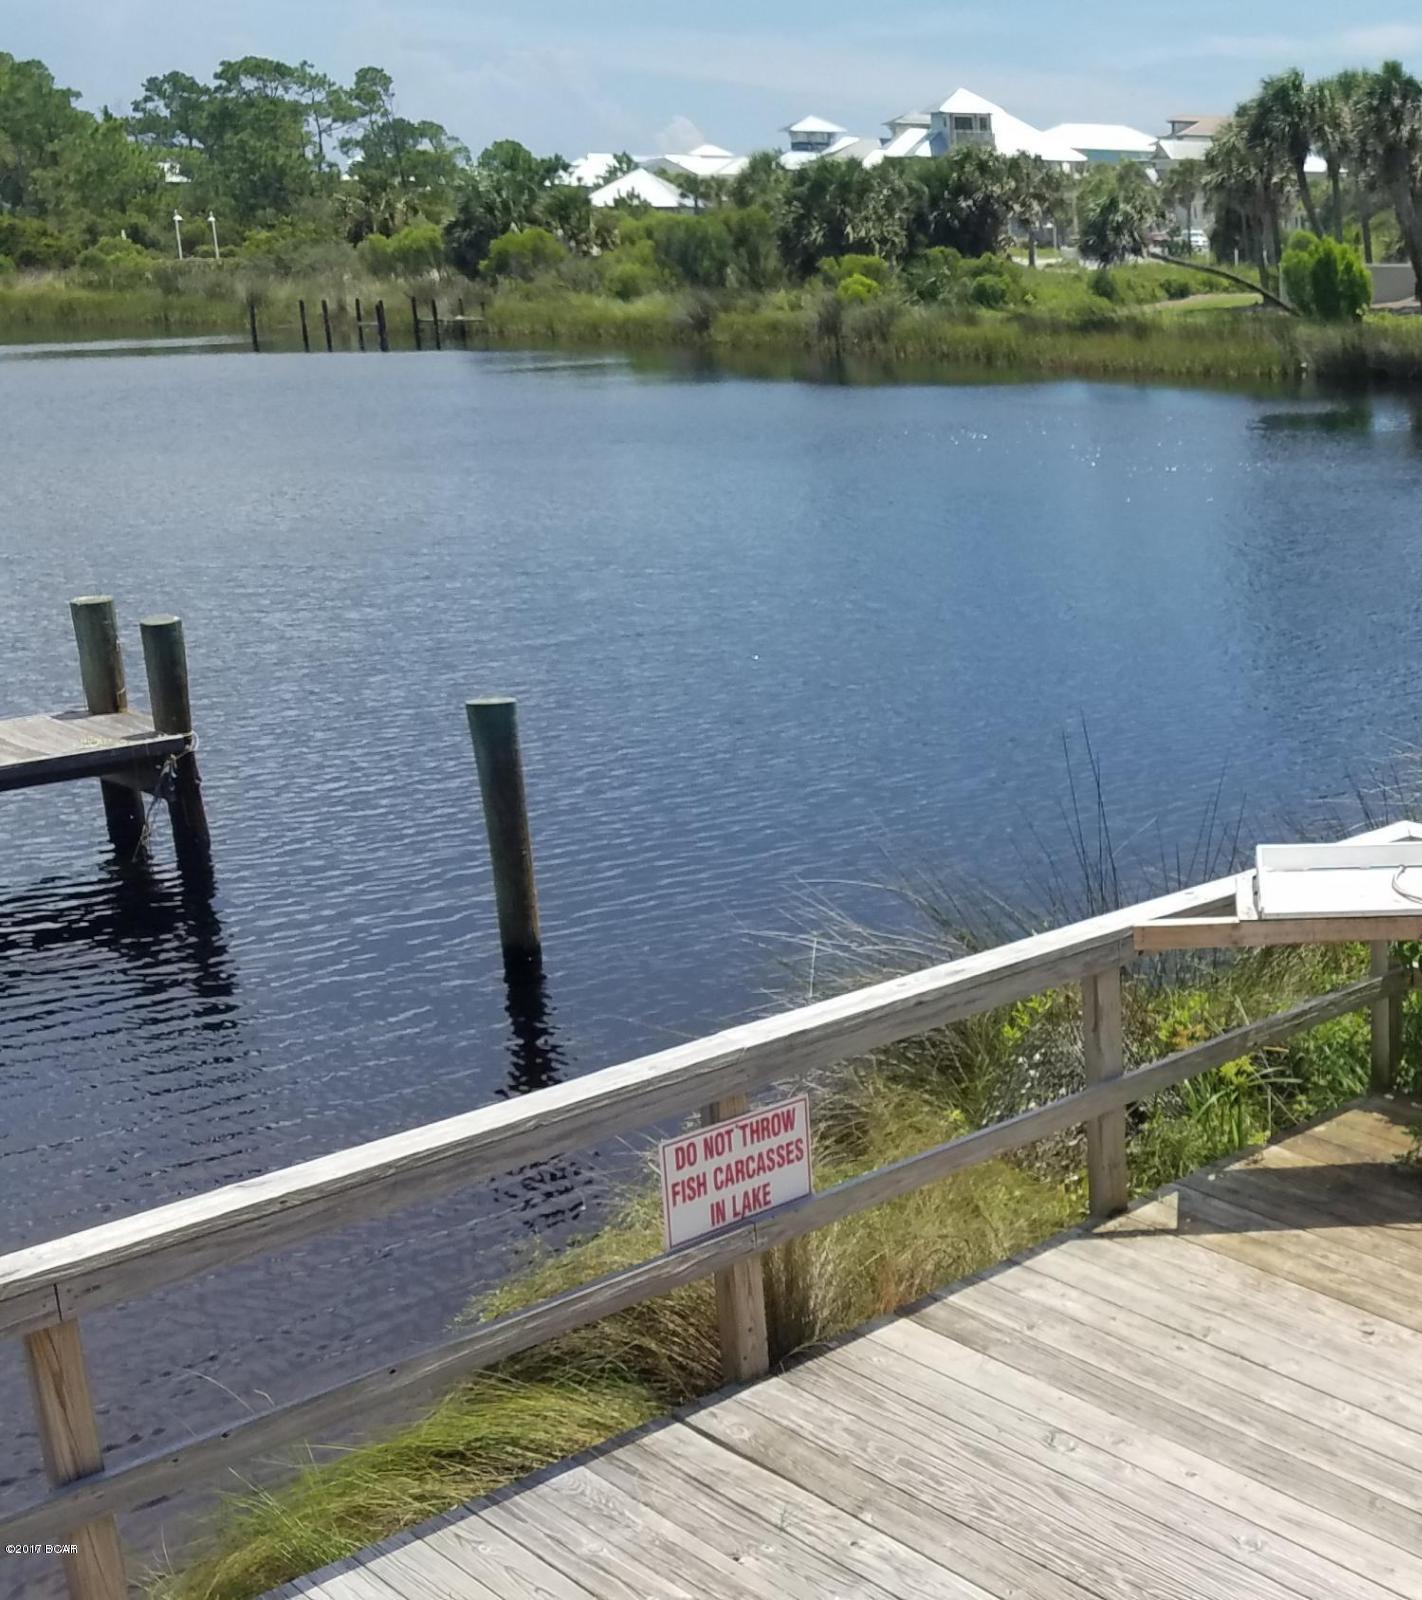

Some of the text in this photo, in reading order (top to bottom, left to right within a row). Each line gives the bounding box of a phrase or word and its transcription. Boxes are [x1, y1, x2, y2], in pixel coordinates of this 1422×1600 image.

[674, 1107, 796, 1171] DO NOT THROW
[671, 1138, 804, 1207] FISH CARCASSES
[710, 1182, 772, 1227] IN LAKE
